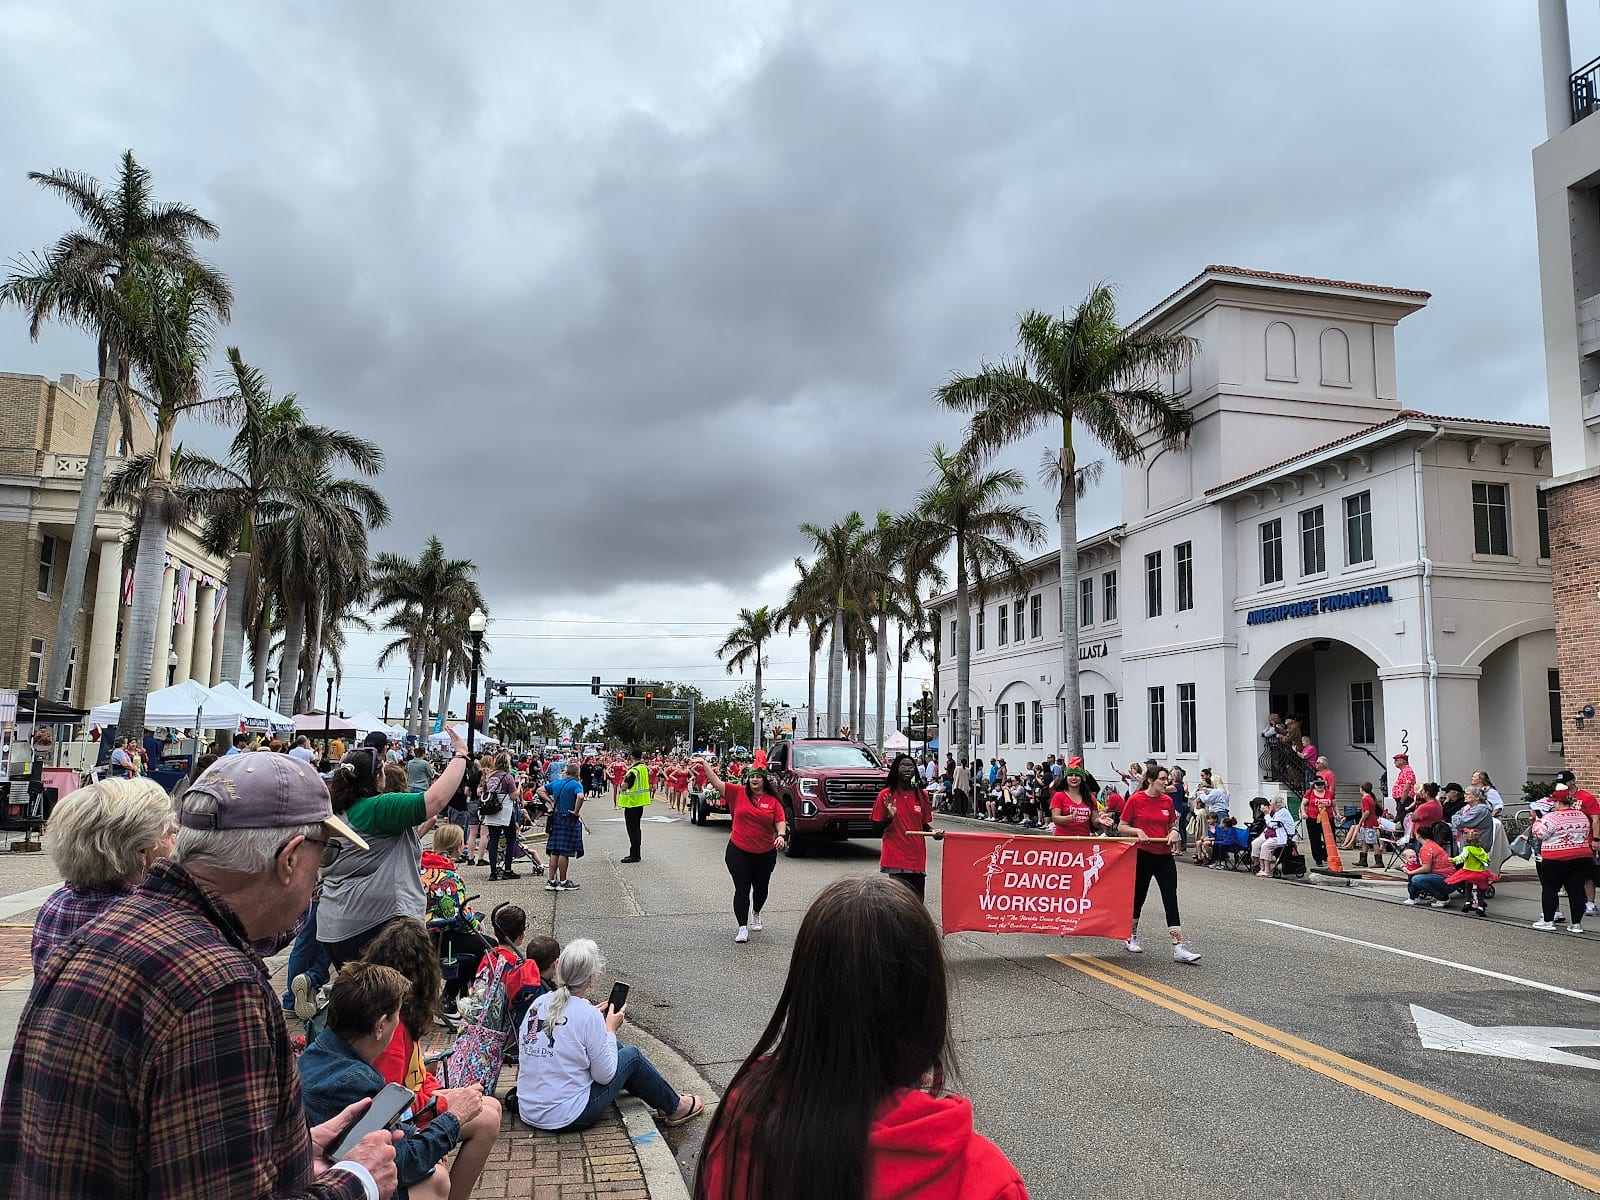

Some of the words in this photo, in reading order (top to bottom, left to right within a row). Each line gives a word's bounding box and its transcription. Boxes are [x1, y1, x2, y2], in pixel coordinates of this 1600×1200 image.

[1247, 599, 1319, 625] AMERIPRISE
[1320, 585, 1392, 613] FINANCIAL
[1078, 644, 1102, 660] LLAST
[1000, 850, 1085, 868] FLORIDA
[1004, 872, 1073, 890] DANCE
[979, 894, 1092, 915] WORKSHOP
[541, 1047, 554, 1058] Dog
